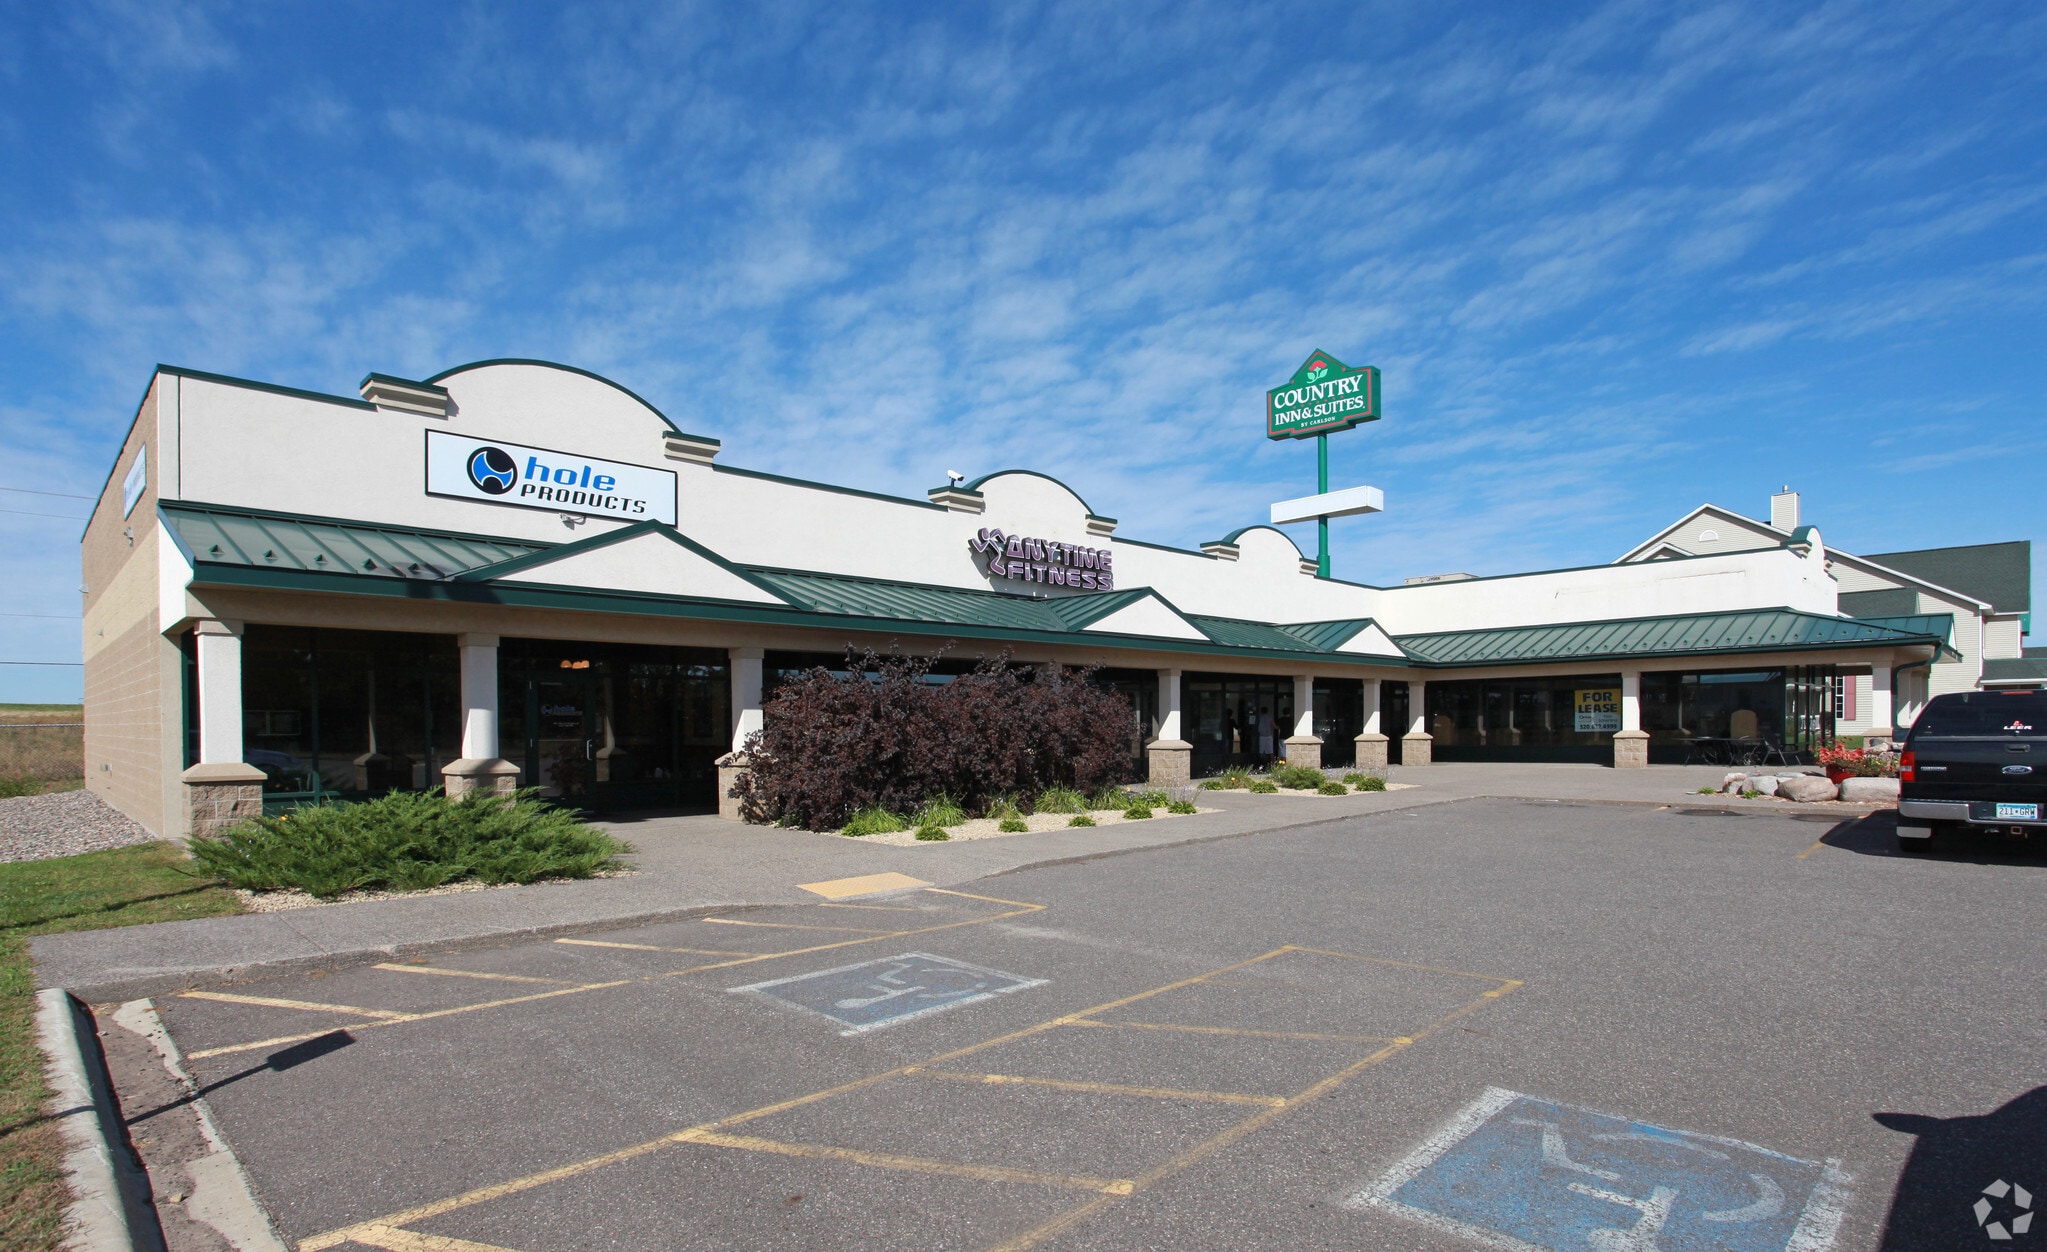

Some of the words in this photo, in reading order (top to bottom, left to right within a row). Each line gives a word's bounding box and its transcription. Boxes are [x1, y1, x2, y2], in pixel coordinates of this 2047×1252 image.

[1274, 374, 1363, 409] COUNTRY
[1309, 416, 1336, 426] CARLSON
[524, 456, 616, 492] hole
[520, 483, 647, 514] PRODUCTS
[1006, 534, 1112, 571] ANYTIME
[1006, 560, 1113, 591] FITNESS
[1578, 703, 1618, 713] LEASE
[1582, 691, 1612, 702] FOR
